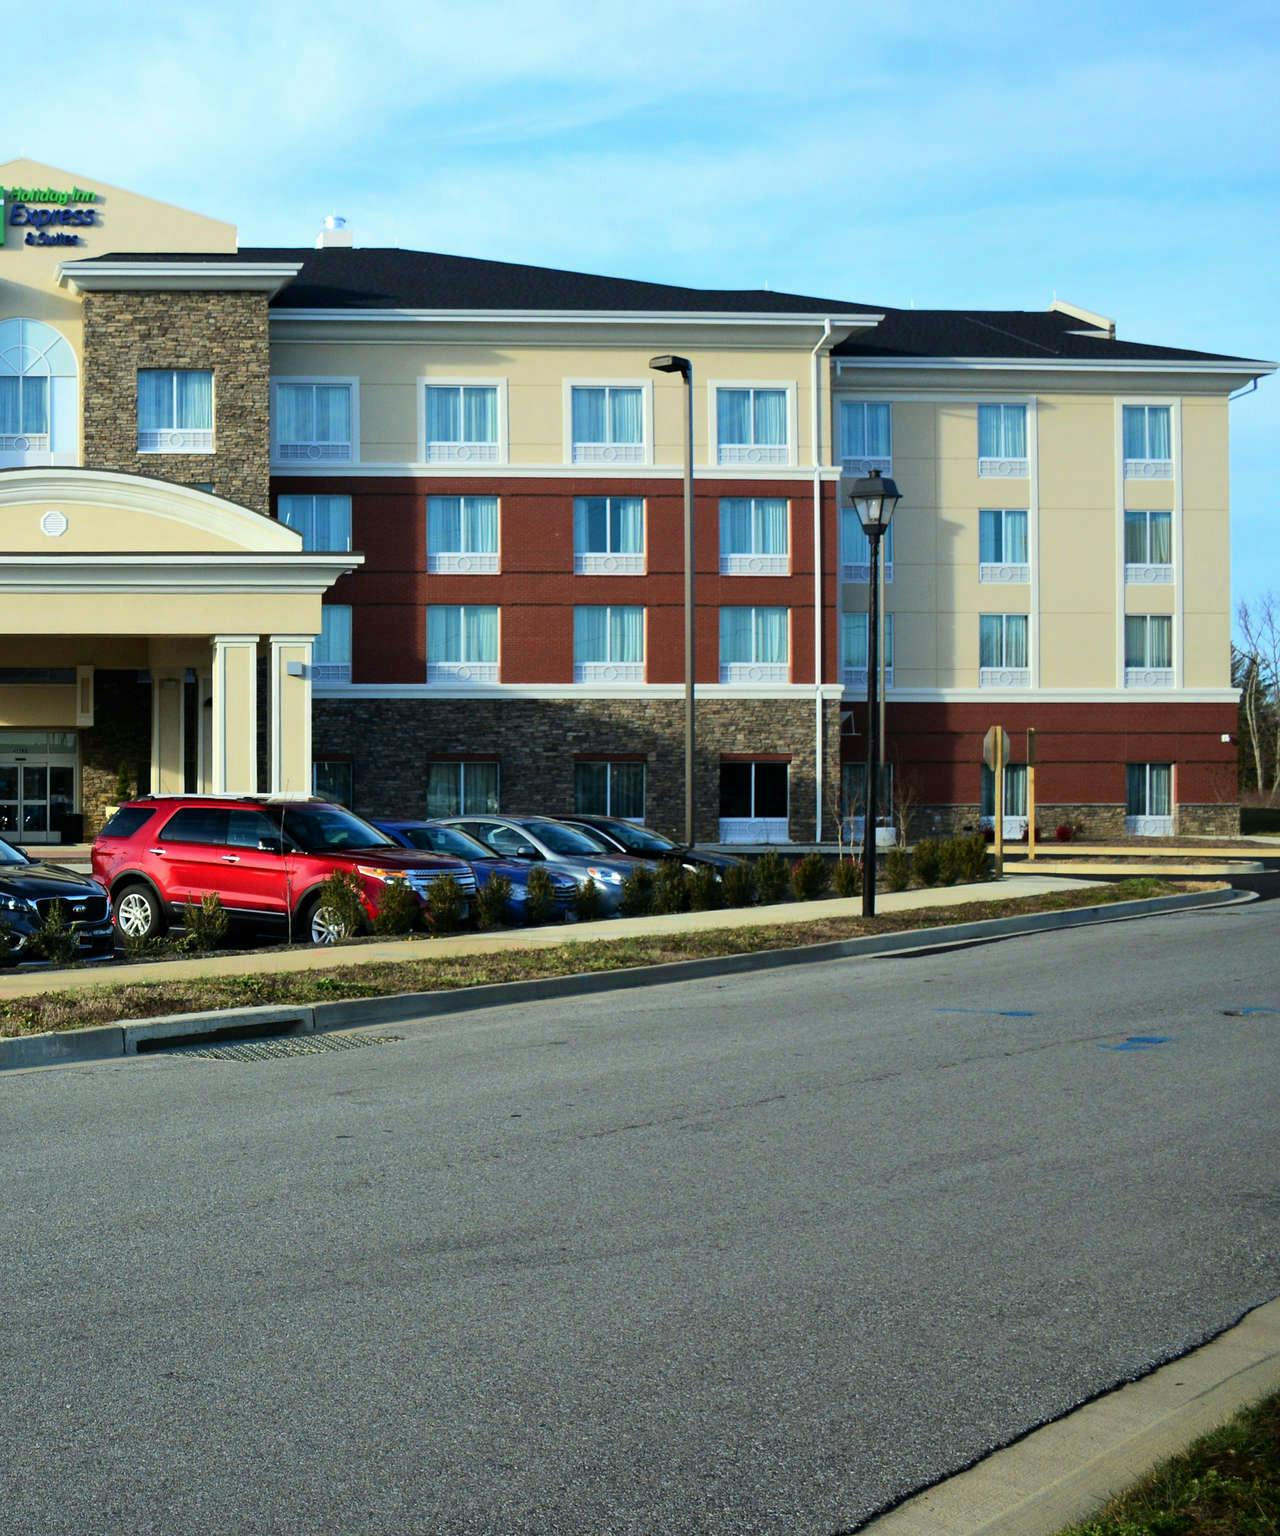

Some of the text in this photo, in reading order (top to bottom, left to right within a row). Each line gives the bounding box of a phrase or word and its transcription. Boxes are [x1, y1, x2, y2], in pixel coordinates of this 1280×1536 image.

[10, 185, 97, 206] Holiday Inn
[9, 203, 96, 231] Express
[24, 231, 79, 247] & Suites
